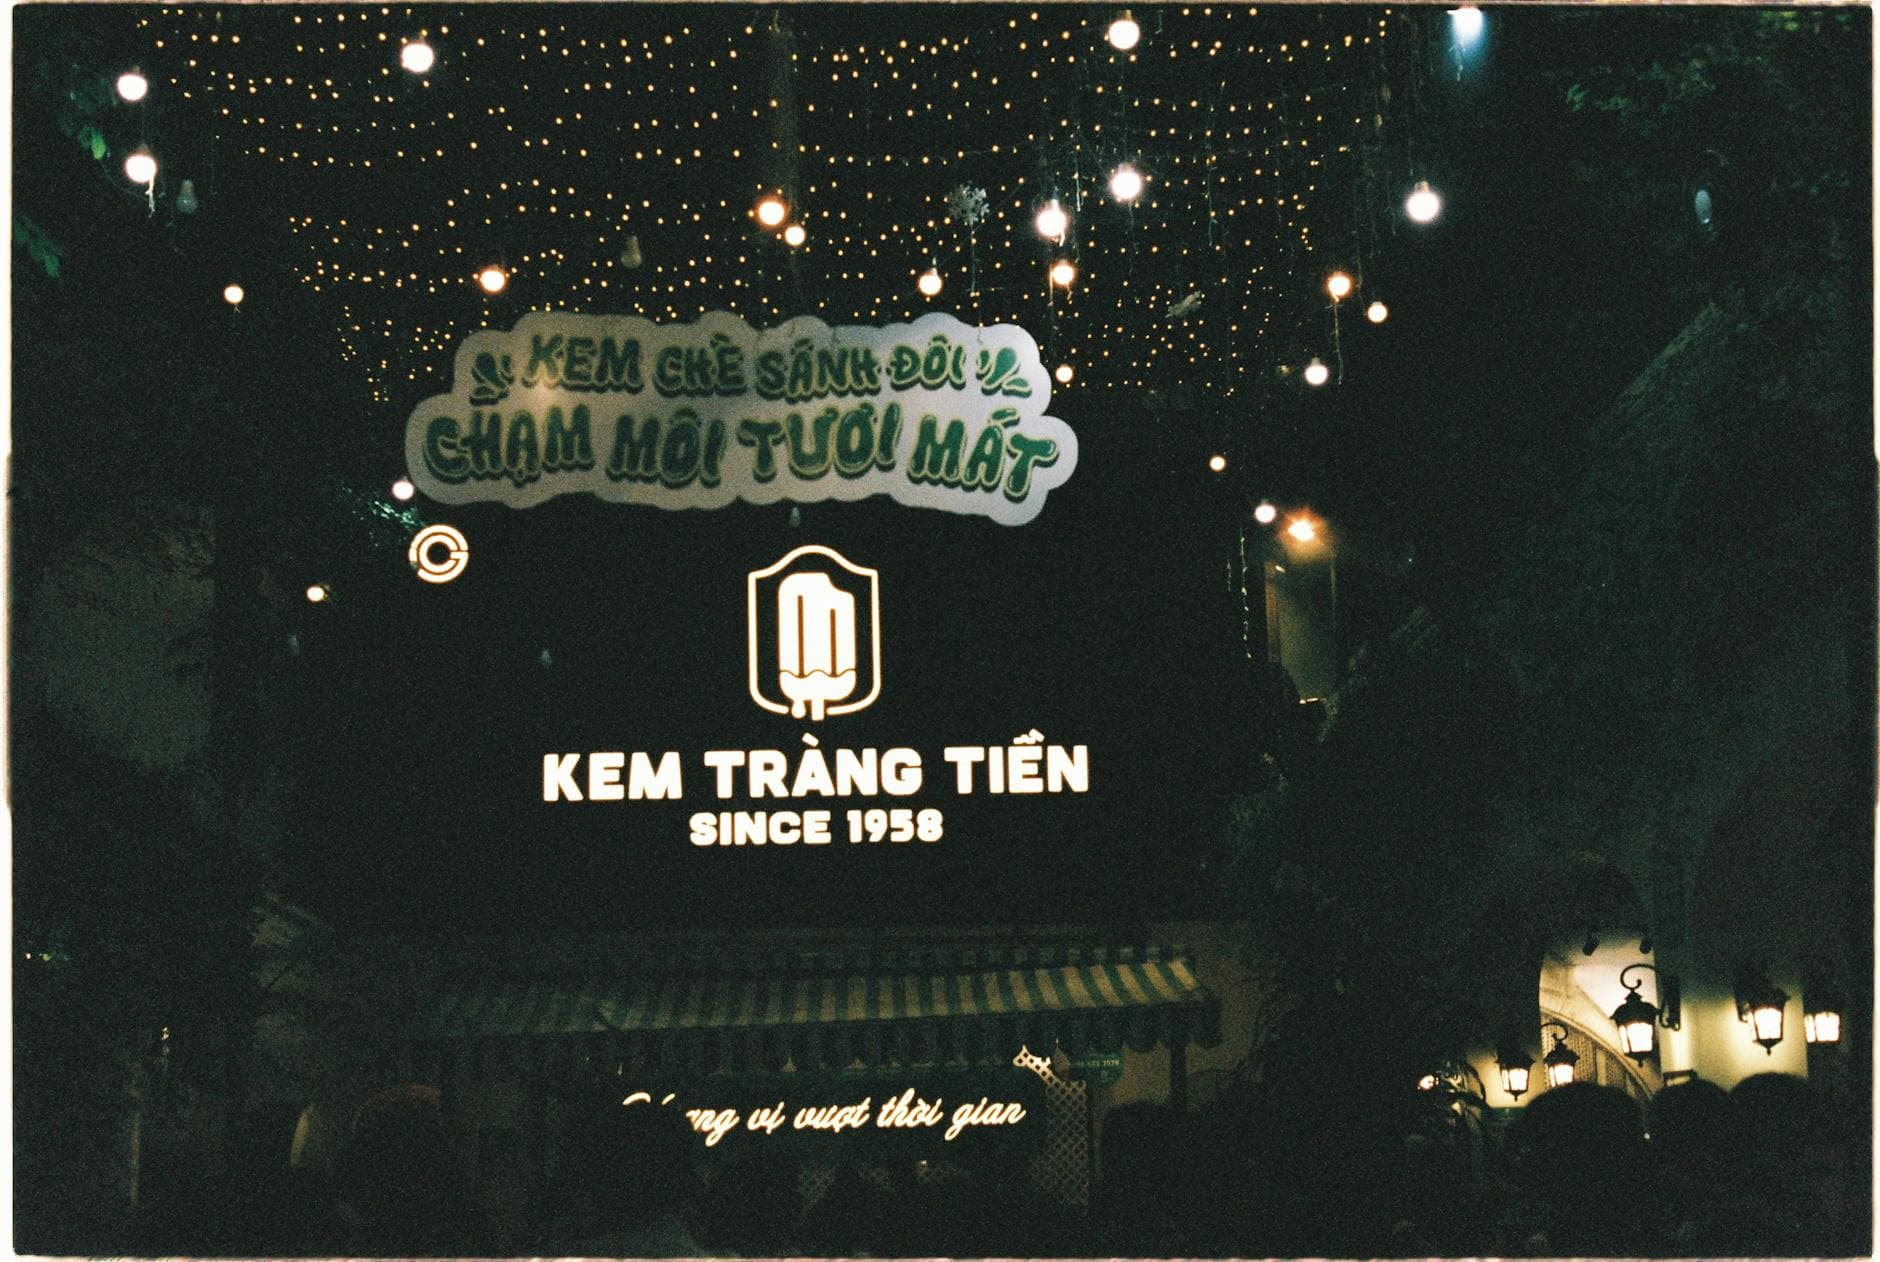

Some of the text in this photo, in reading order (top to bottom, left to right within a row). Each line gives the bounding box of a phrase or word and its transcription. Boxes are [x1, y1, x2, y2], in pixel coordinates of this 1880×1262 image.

[522, 331, 967, 403] KEM CHÈ SÁNH ĐÔI
[424, 402, 1059, 503] CHẠM MÔI TƯƠI MÁT
[543, 729, 1088, 801] KEM TRÀNG TIỀN
[689, 809, 943, 846] SINCE 1958
[747, 1102, 785, 1134] vị
[793, 1097, 871, 1133] vượt
[877, 1088, 943, 1127] thời
[945, 1097, 1026, 1140] gian
